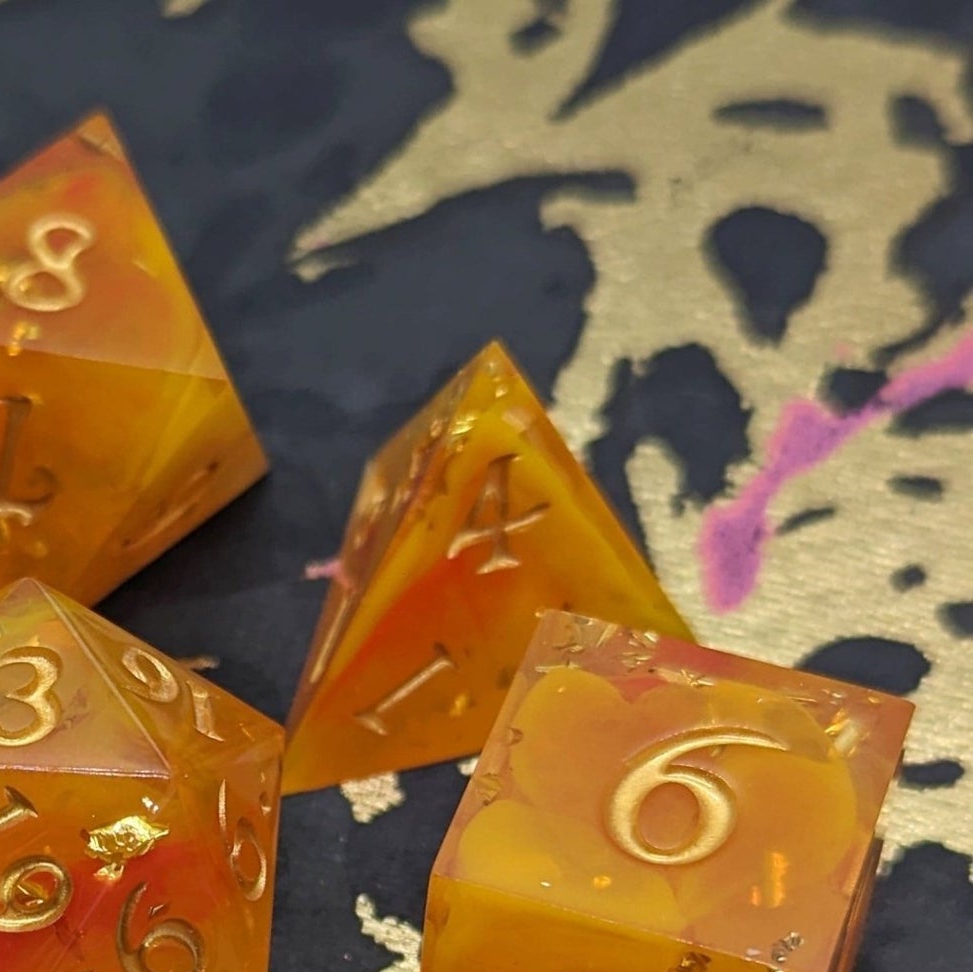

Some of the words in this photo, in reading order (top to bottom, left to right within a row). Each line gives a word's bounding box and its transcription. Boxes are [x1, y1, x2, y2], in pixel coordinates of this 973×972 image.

[7, 213, 97, 312] 8
[446, 452, 552, 575] 4
[606, 725, 790, 867] 6
